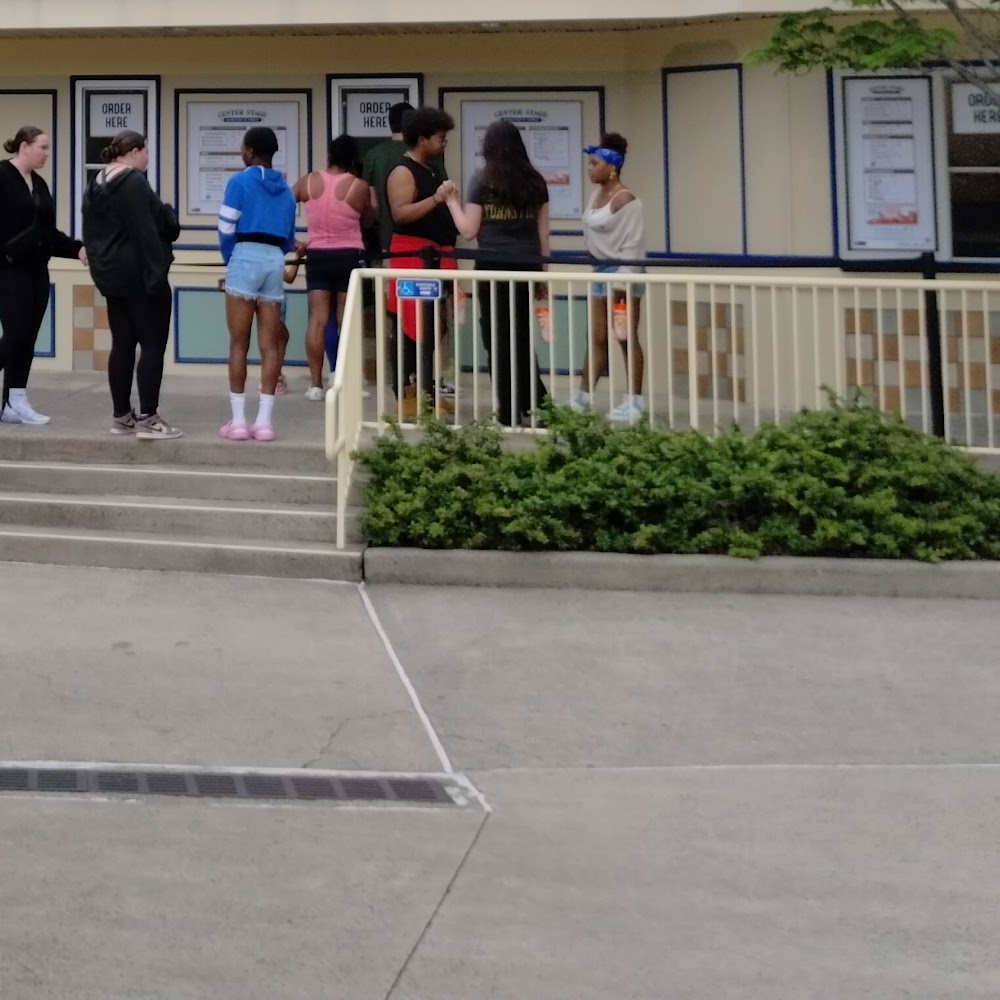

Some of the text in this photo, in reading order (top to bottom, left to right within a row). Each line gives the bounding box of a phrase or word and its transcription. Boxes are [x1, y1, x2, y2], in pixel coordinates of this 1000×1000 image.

[102, 103, 131, 115] ORDER
[360, 101, 391, 114] ORDER
[105, 116, 128, 128] HERE
[363, 116, 388, 128] HERE
